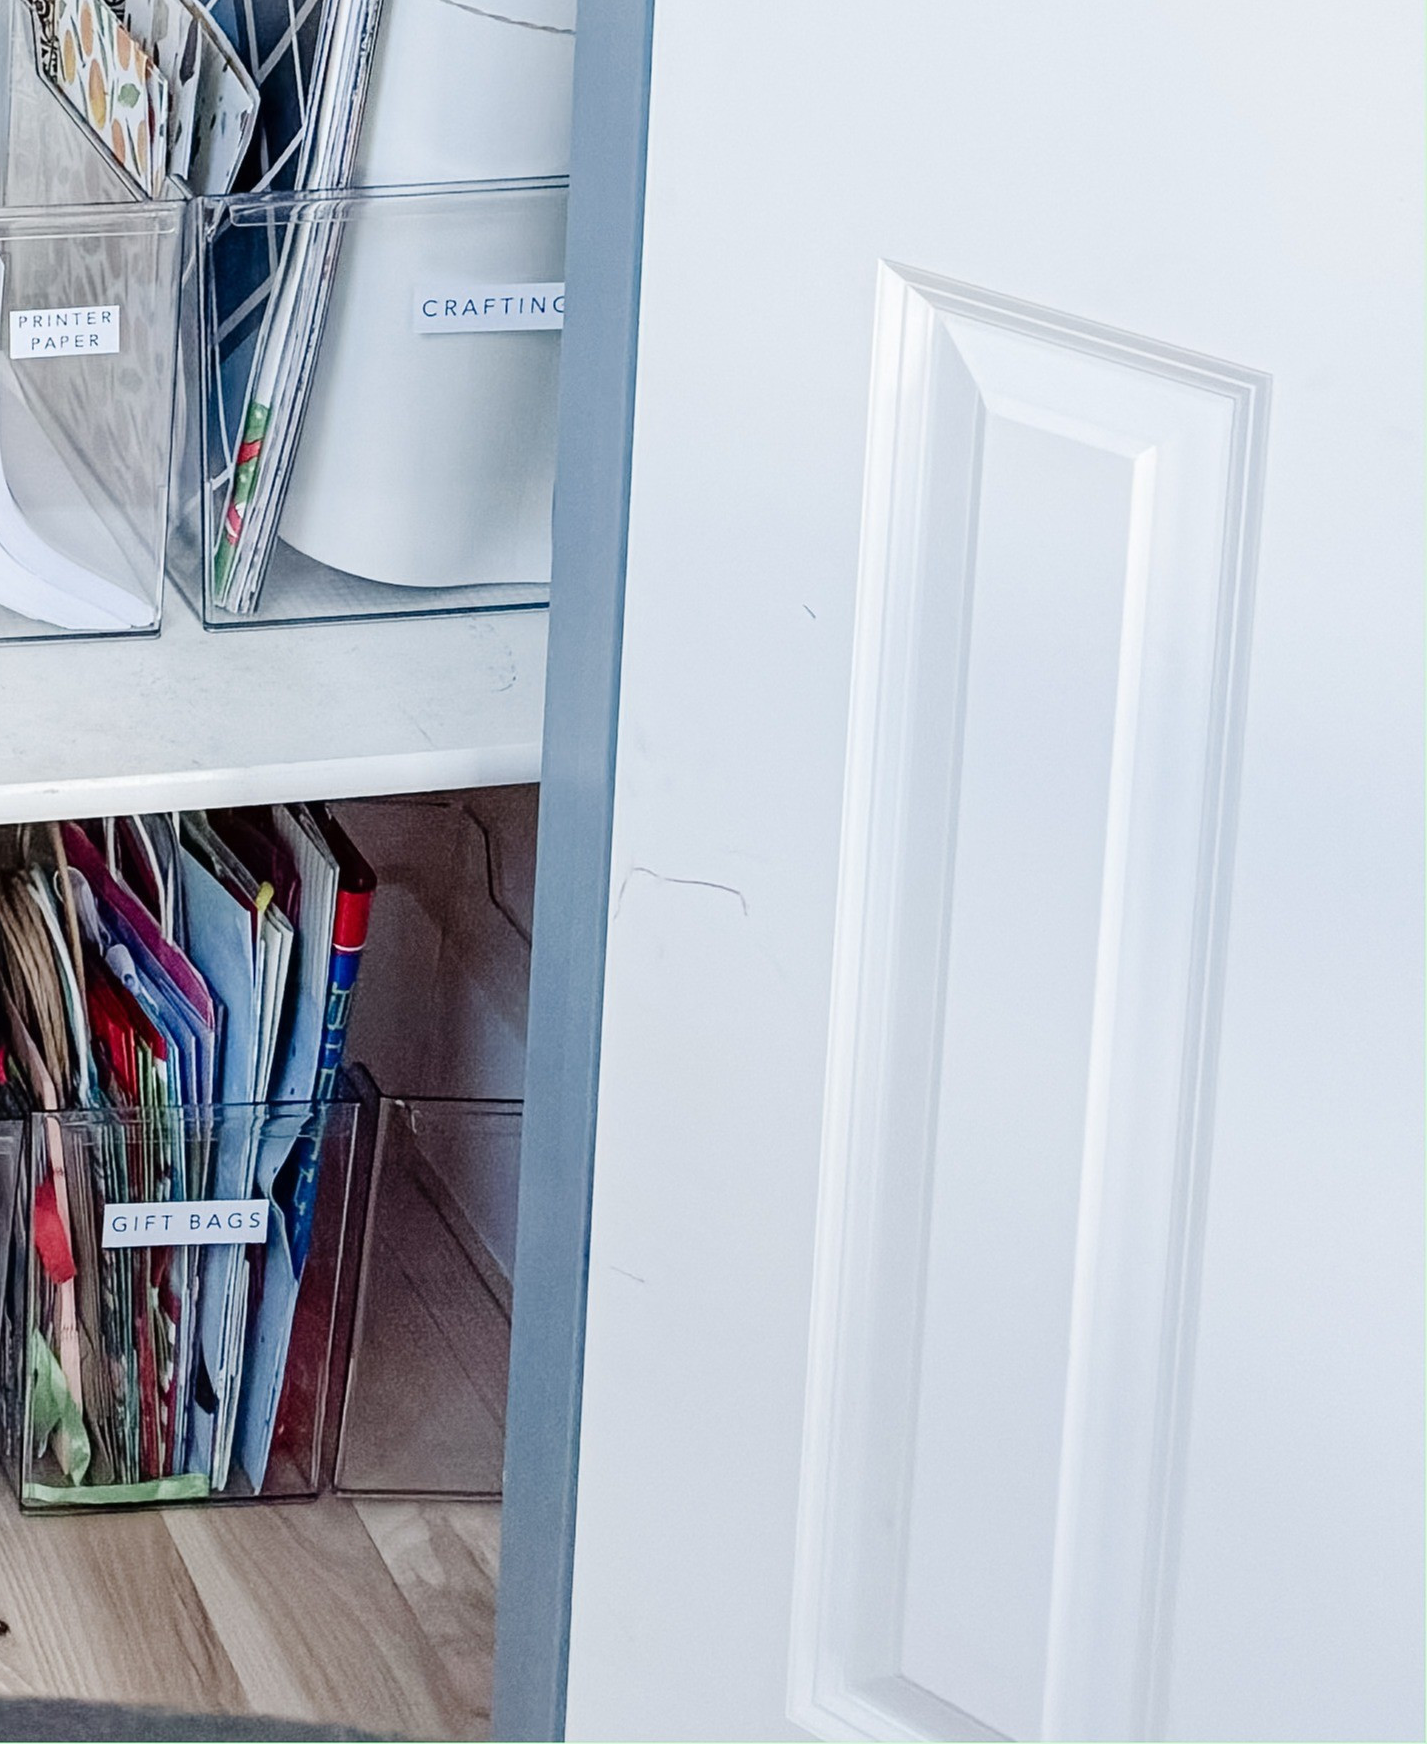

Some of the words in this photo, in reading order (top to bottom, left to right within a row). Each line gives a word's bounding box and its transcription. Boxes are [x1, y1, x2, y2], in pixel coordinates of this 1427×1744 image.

[18, 310, 112, 329] PRINTER
[31, 333, 99, 351] PAPER
[111, 1214, 174, 1233] GIFT
[189, 1211, 261, 1231] BAGS
